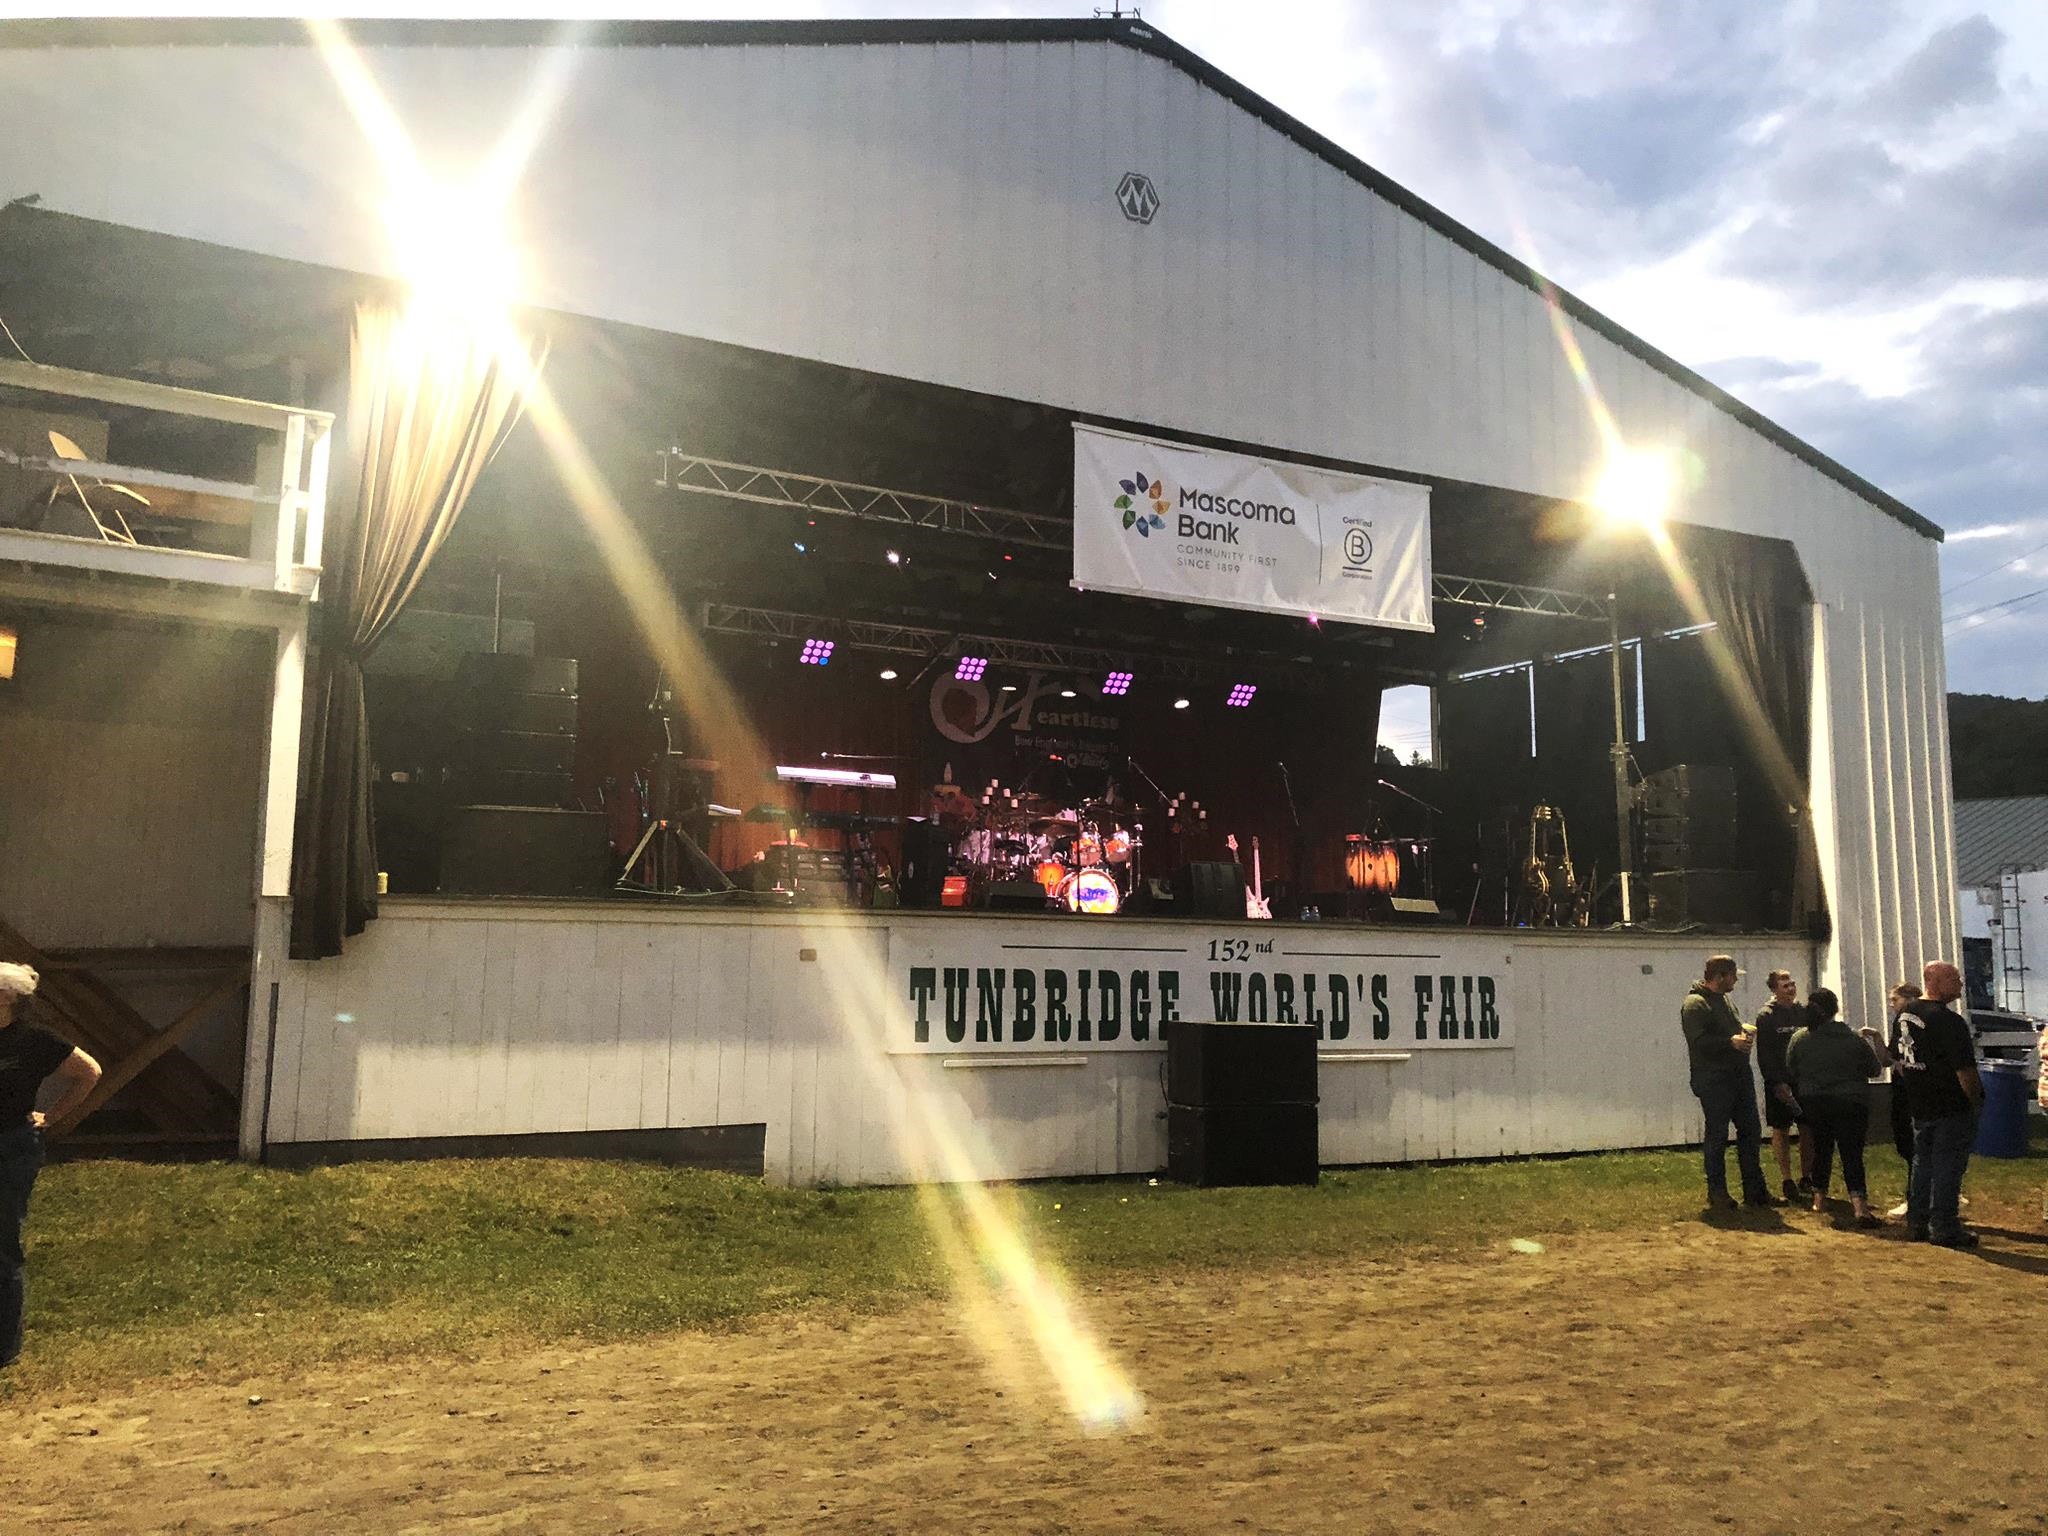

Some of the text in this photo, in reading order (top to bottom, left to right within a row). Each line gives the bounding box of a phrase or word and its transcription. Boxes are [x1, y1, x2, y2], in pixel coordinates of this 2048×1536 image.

[1093, 7, 1101, 18] S
[1133, 7, 1141, 19] N
[1179, 486, 1296, 526] Mascoma
[1178, 513, 1240, 545] Bank
[1176, 544, 1278, 569] COMMUNITY FIRST
[1351, 535, 1365, 557] B
[1176, 557, 1241, 574] SINCE 1899
[1206, 938, 1275, 962] 152nd
[909, 967, 1500, 1043] TUNBRIDGE WORLD'S FAIR
